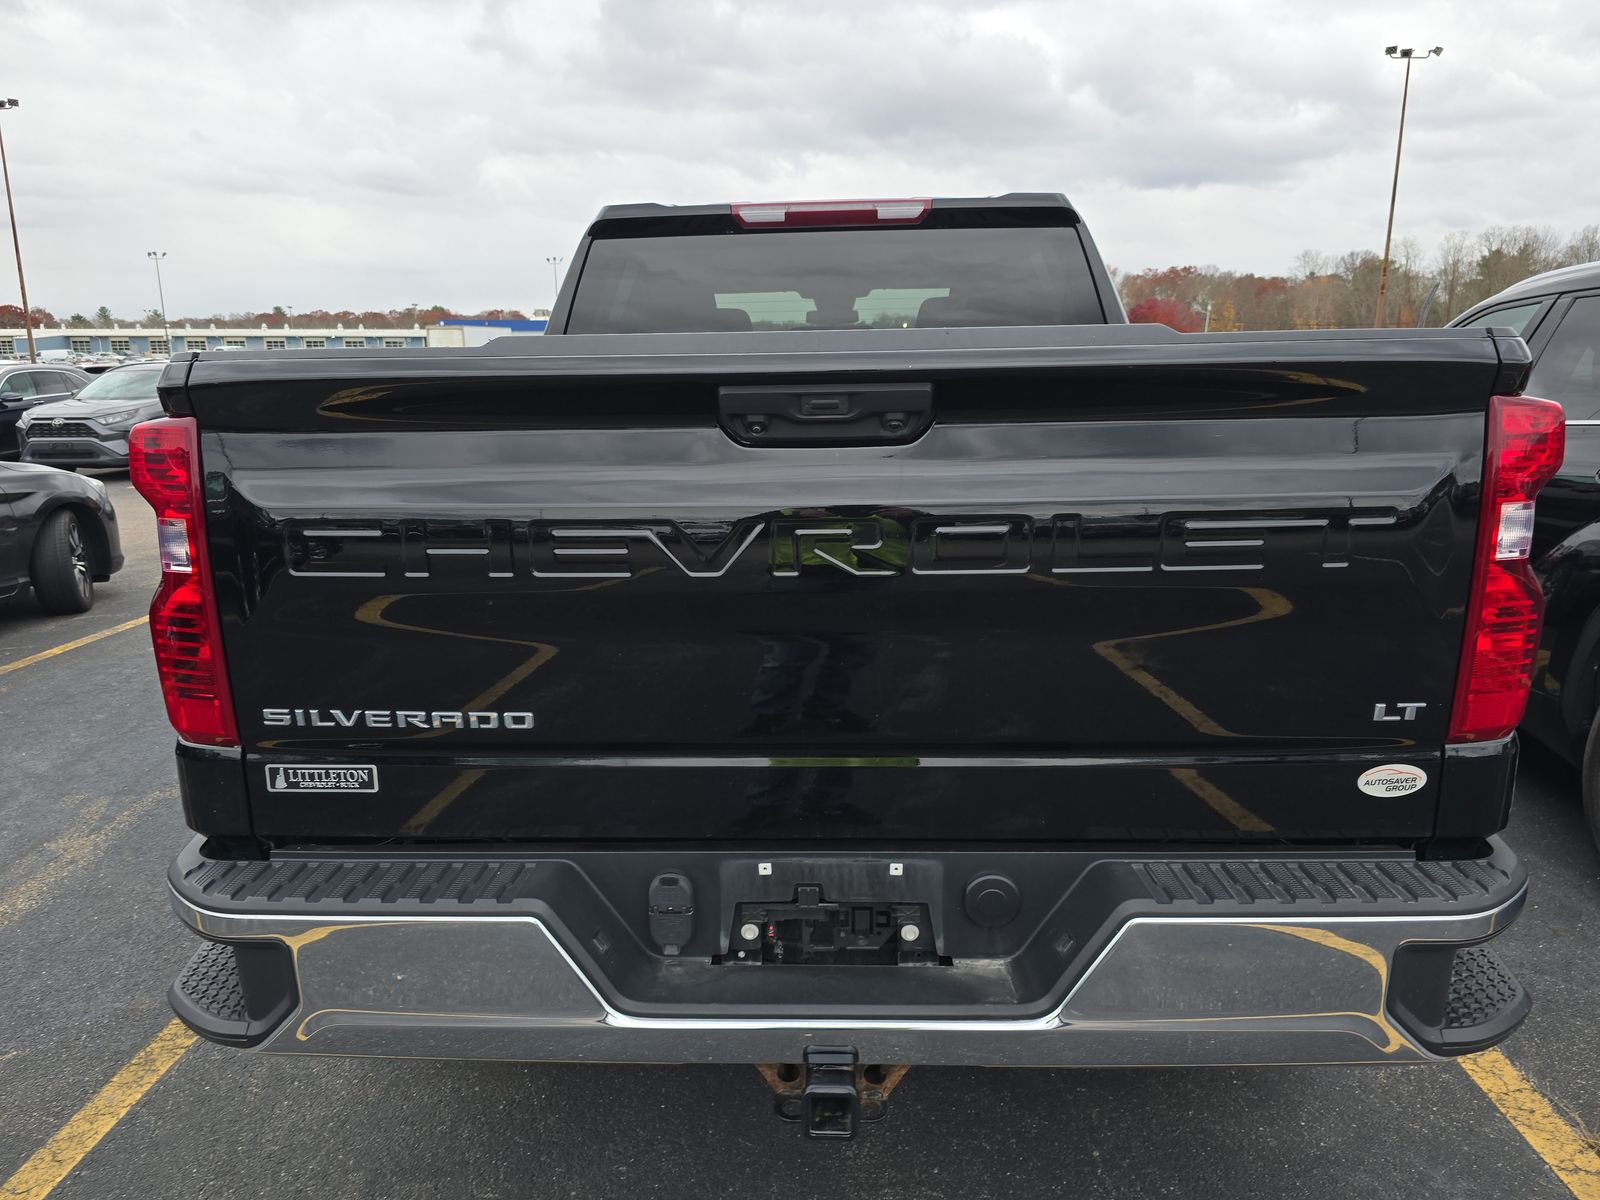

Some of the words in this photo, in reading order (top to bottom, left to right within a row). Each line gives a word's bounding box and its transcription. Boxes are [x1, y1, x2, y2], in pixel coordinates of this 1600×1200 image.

[284, 507, 1399, 578] CHEVROLET
[262, 708, 534, 729] SILVERADO
[1373, 702, 1427, 721] LT
[287, 769, 369, 782] LITTLETON
[1363, 776, 1418, 787] AUTOSAVER
[1385, 783, 1417, 792] GROUP
